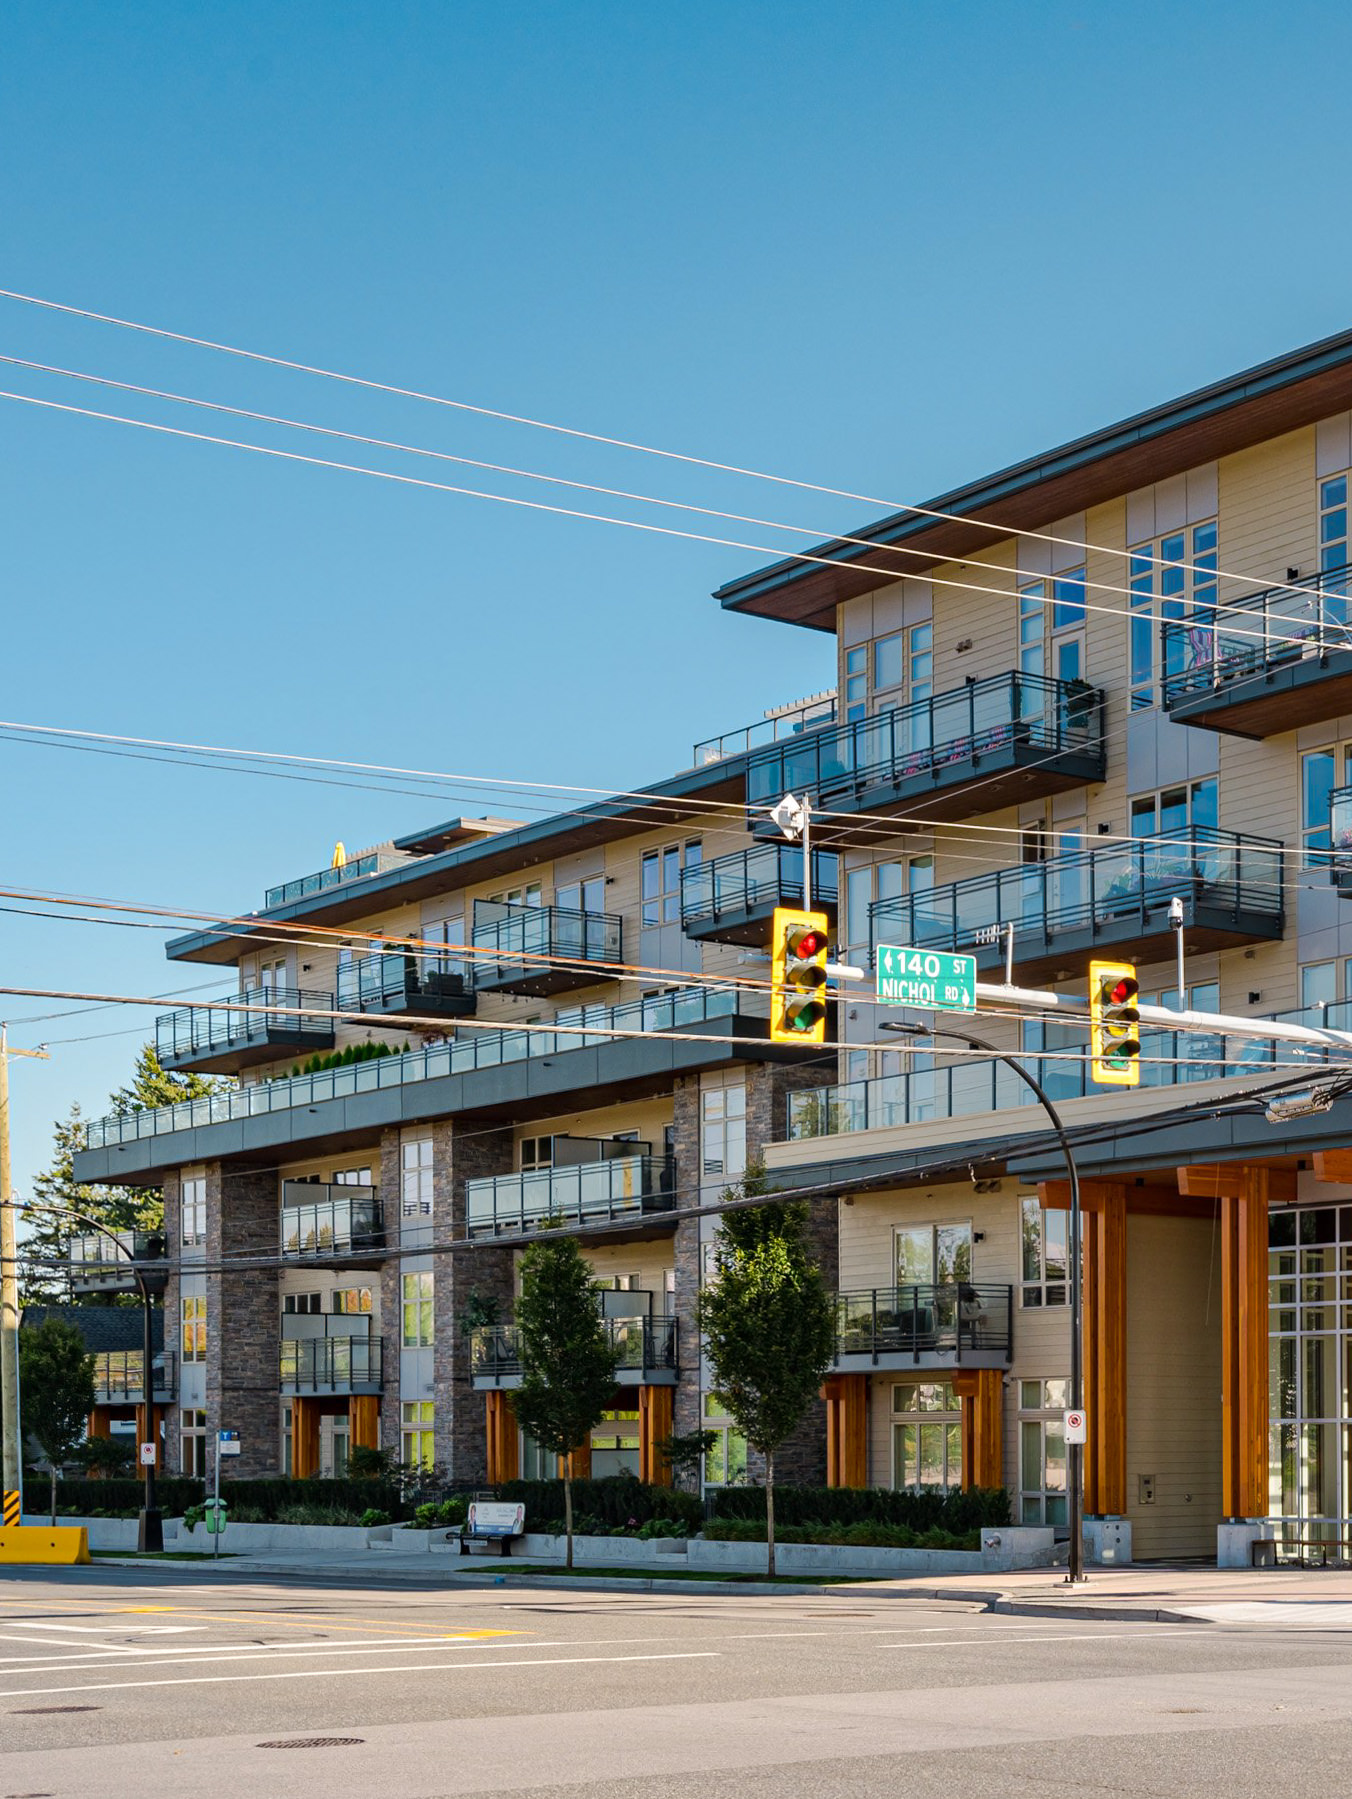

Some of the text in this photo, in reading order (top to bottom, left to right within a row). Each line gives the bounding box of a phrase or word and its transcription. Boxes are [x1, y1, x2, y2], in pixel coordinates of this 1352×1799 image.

[897, 951, 967, 978] 140 ST
[882, 978, 959, 1006] NICHOL RD
